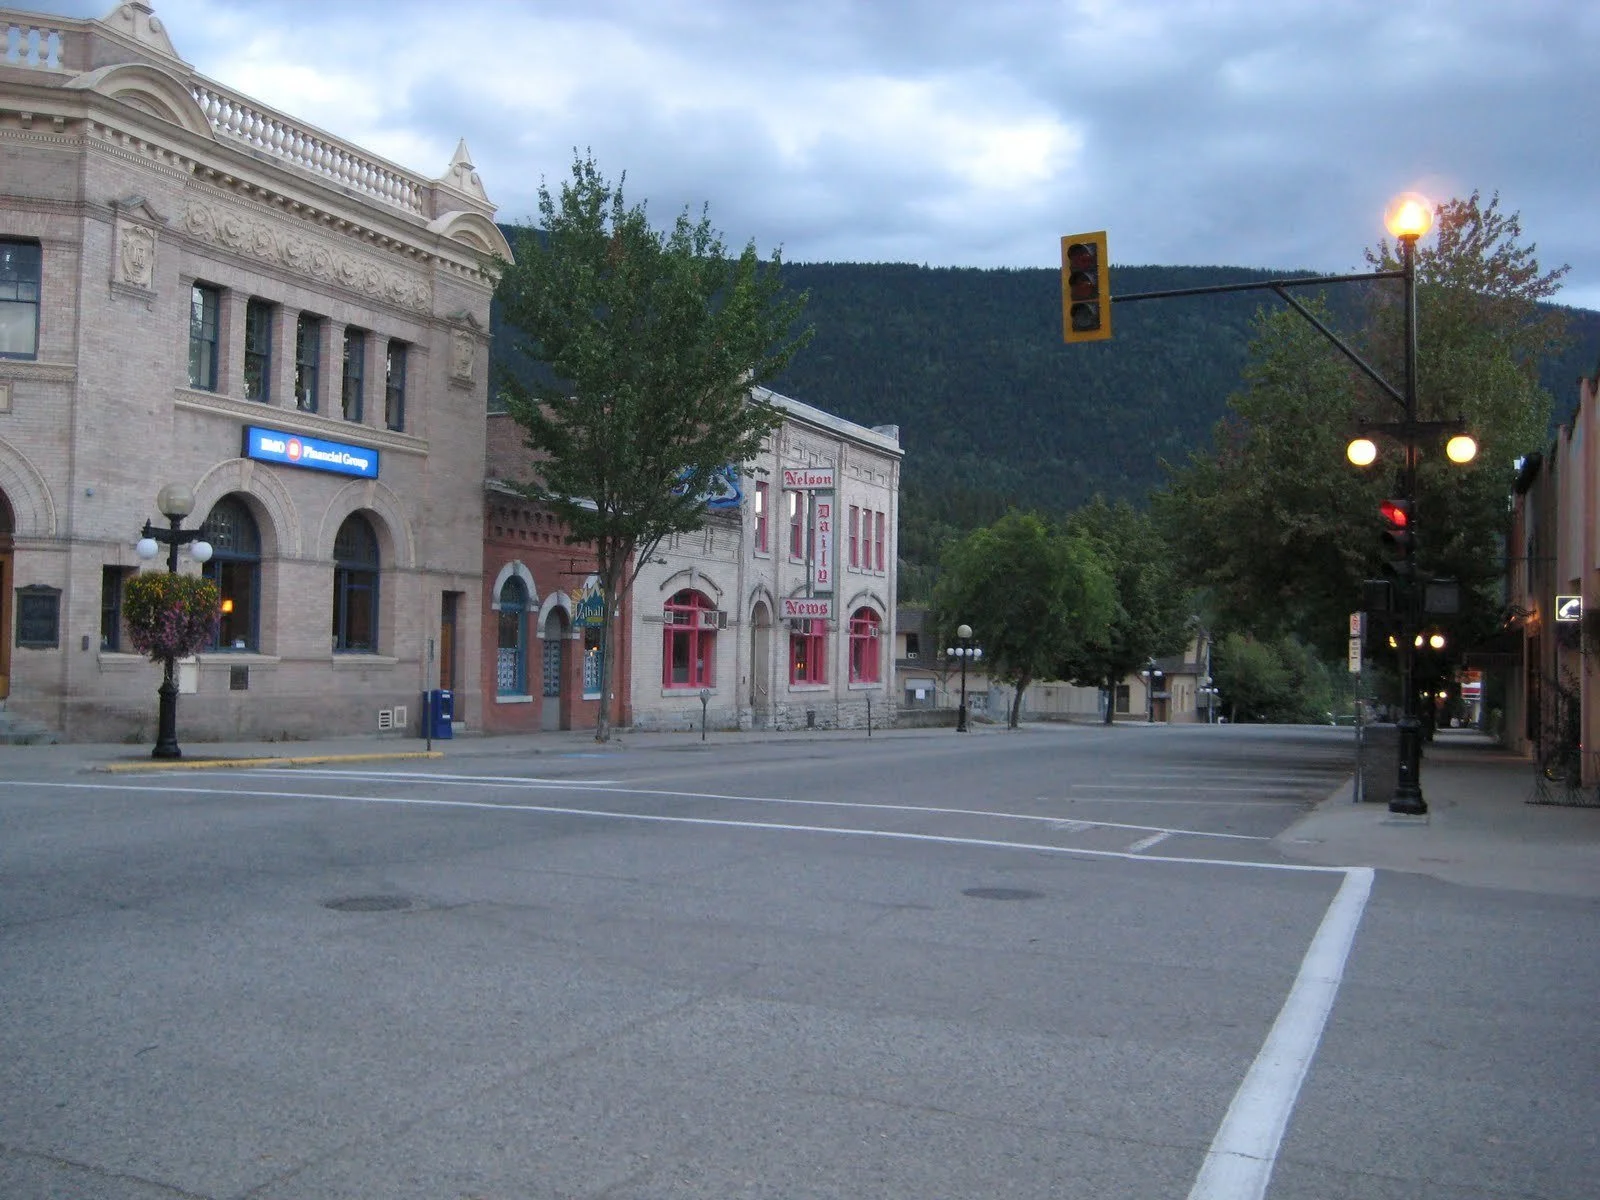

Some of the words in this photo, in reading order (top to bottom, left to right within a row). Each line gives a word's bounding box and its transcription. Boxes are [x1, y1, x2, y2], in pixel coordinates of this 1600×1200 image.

[303, 445, 342, 464] Financial
[342, 453, 369, 470] Group
[784, 471, 832, 486] Nelson
[817, 503, 830, 583] Daily
[575, 602, 604, 621] Valhall
[785, 600, 828, 616] News
